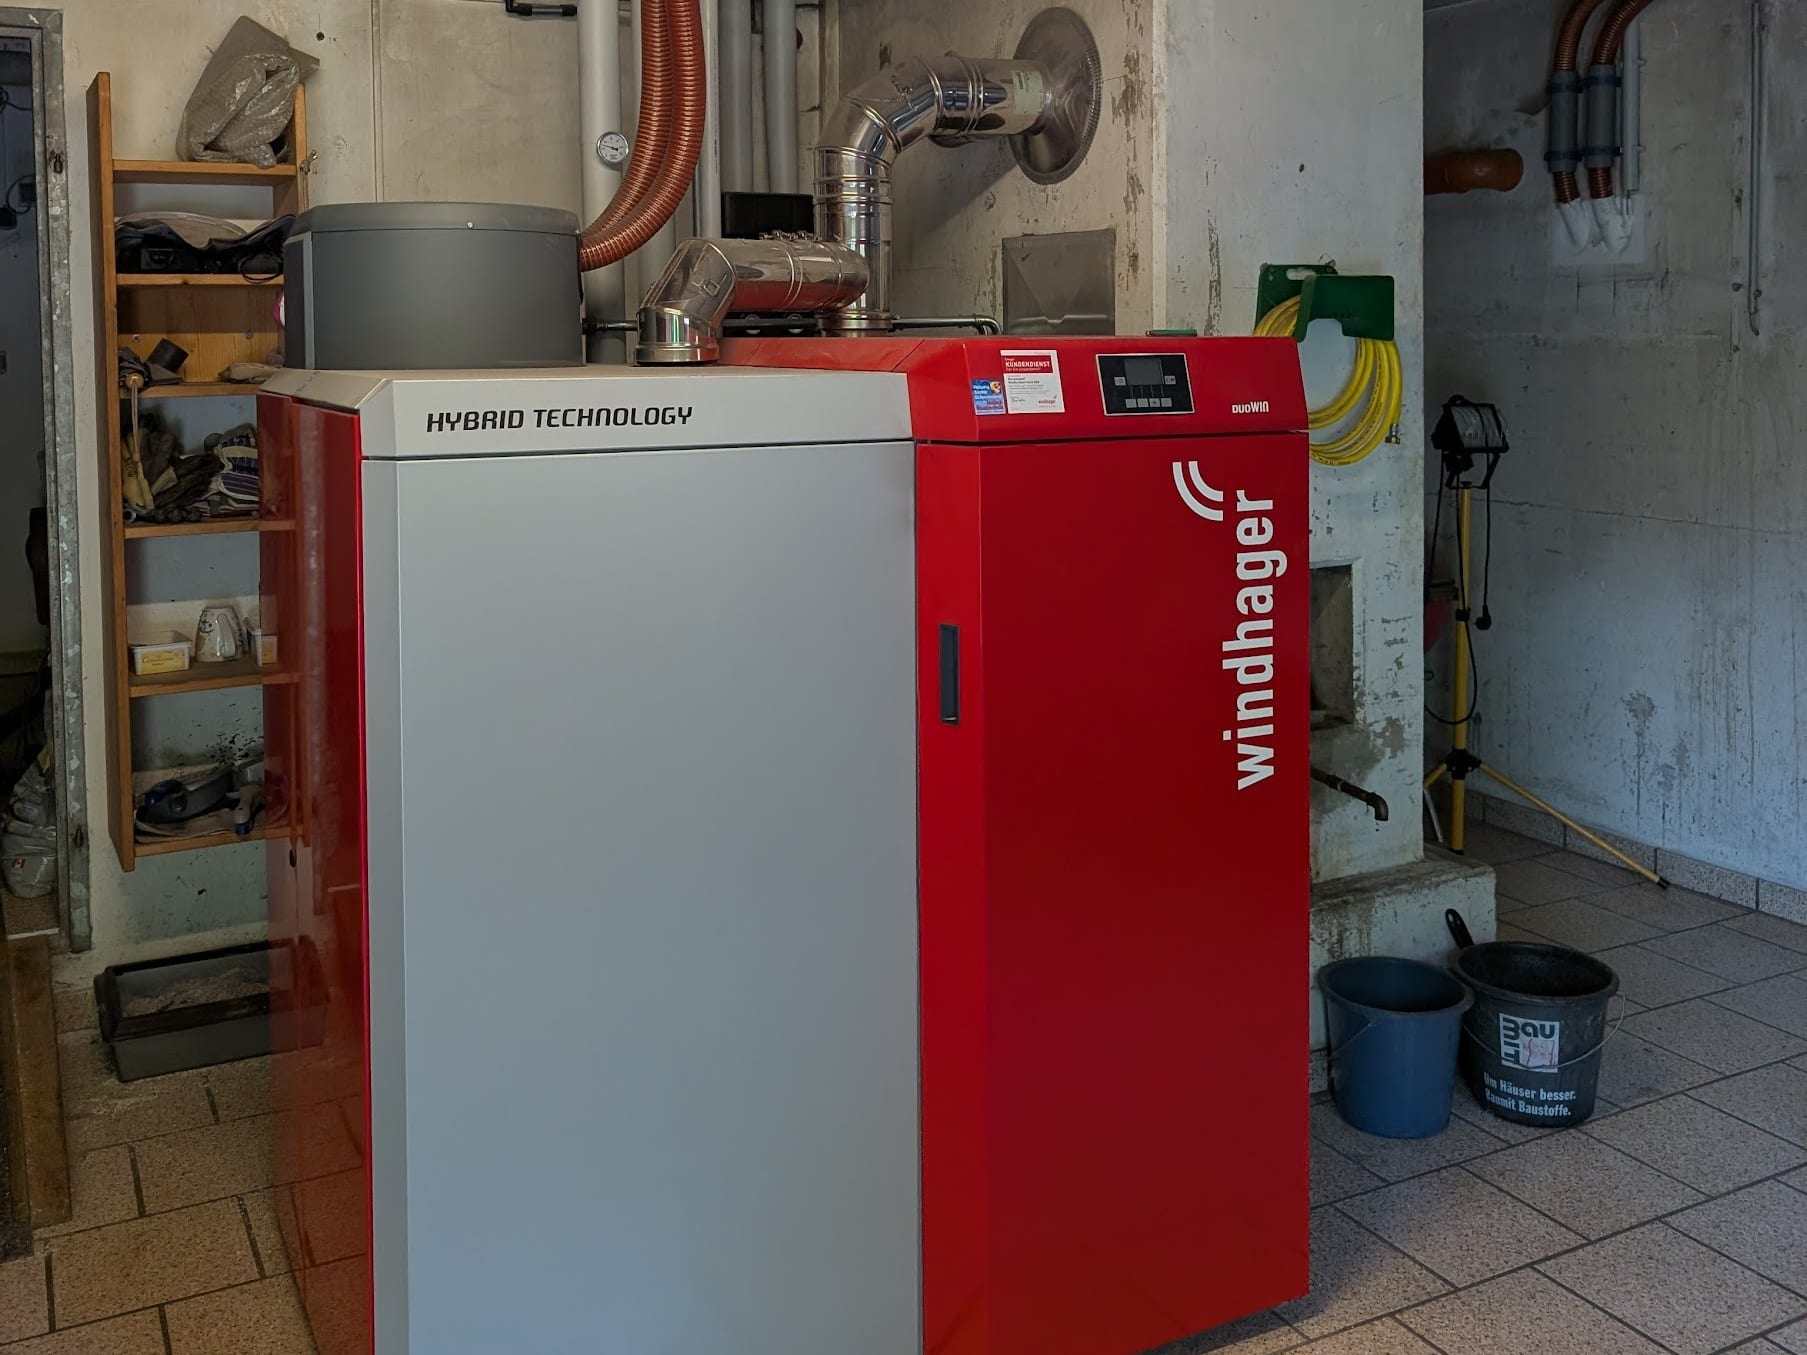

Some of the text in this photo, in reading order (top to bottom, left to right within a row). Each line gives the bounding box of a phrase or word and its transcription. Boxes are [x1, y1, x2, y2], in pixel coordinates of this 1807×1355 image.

[426, 406, 693, 432] HYBRID TECHNOLOGY
[1222, 490, 1288, 791] windhager
[1499, 1079, 1536, 1099] Häuser
[1540, 1088, 1576, 1101] besser.
[1518, 1100, 1571, 1117] Baustoffe.
